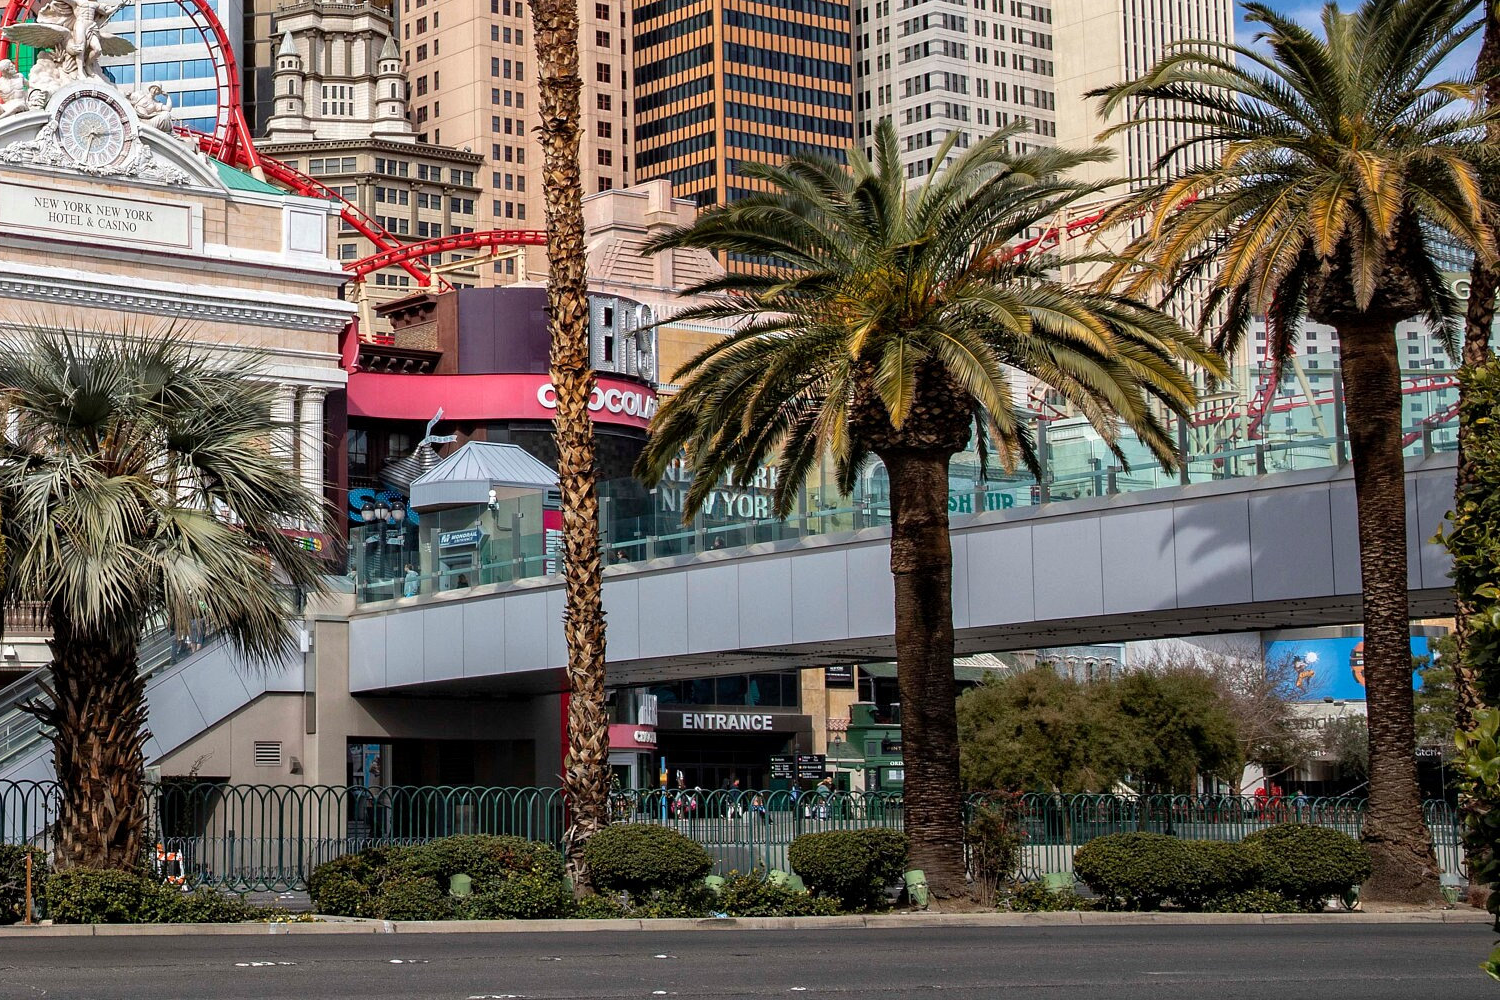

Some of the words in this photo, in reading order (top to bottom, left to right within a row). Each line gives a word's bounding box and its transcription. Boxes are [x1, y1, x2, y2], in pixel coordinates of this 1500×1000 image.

[33, 196, 59, 209] NEW
[63, 200, 92, 214] YORK
[96, 205, 121, 217] NEW
[124, 208, 153, 222] YORK
[48, 211, 83, 226] HOTEL
[86, 216, 94, 228] &
[97, 218, 137, 232] CASINO
[682, 713, 773, 731] ENTRANCE
